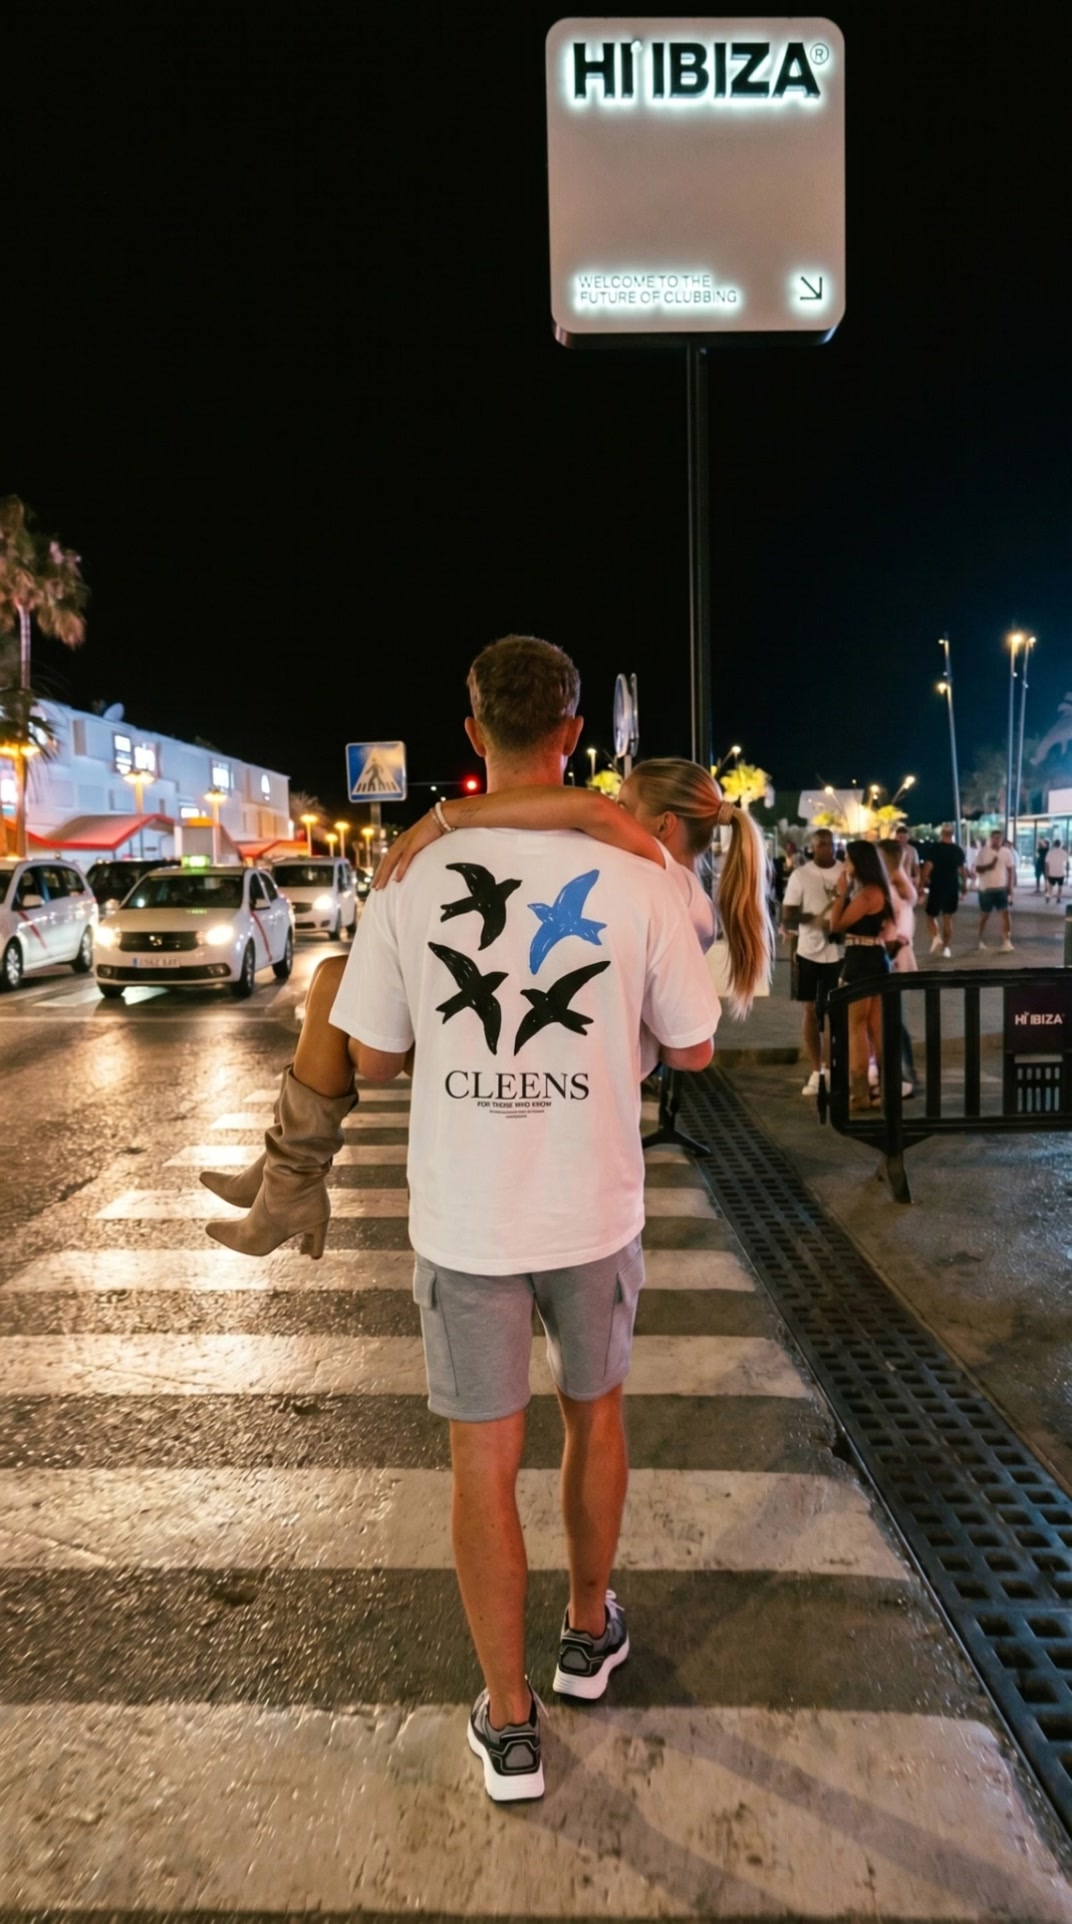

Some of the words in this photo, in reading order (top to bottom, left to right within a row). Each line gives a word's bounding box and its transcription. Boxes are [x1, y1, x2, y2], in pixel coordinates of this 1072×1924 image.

[579, 275, 655, 289] WELCOME
[658, 275, 679, 288] TO
[682, 274, 711, 288] THE
[580, 290, 636, 304] FUTURE
[640, 290, 661, 304] OF
[663, 289, 737, 304] CLUBBING
[445, 1070, 590, 1101] CLEENS
